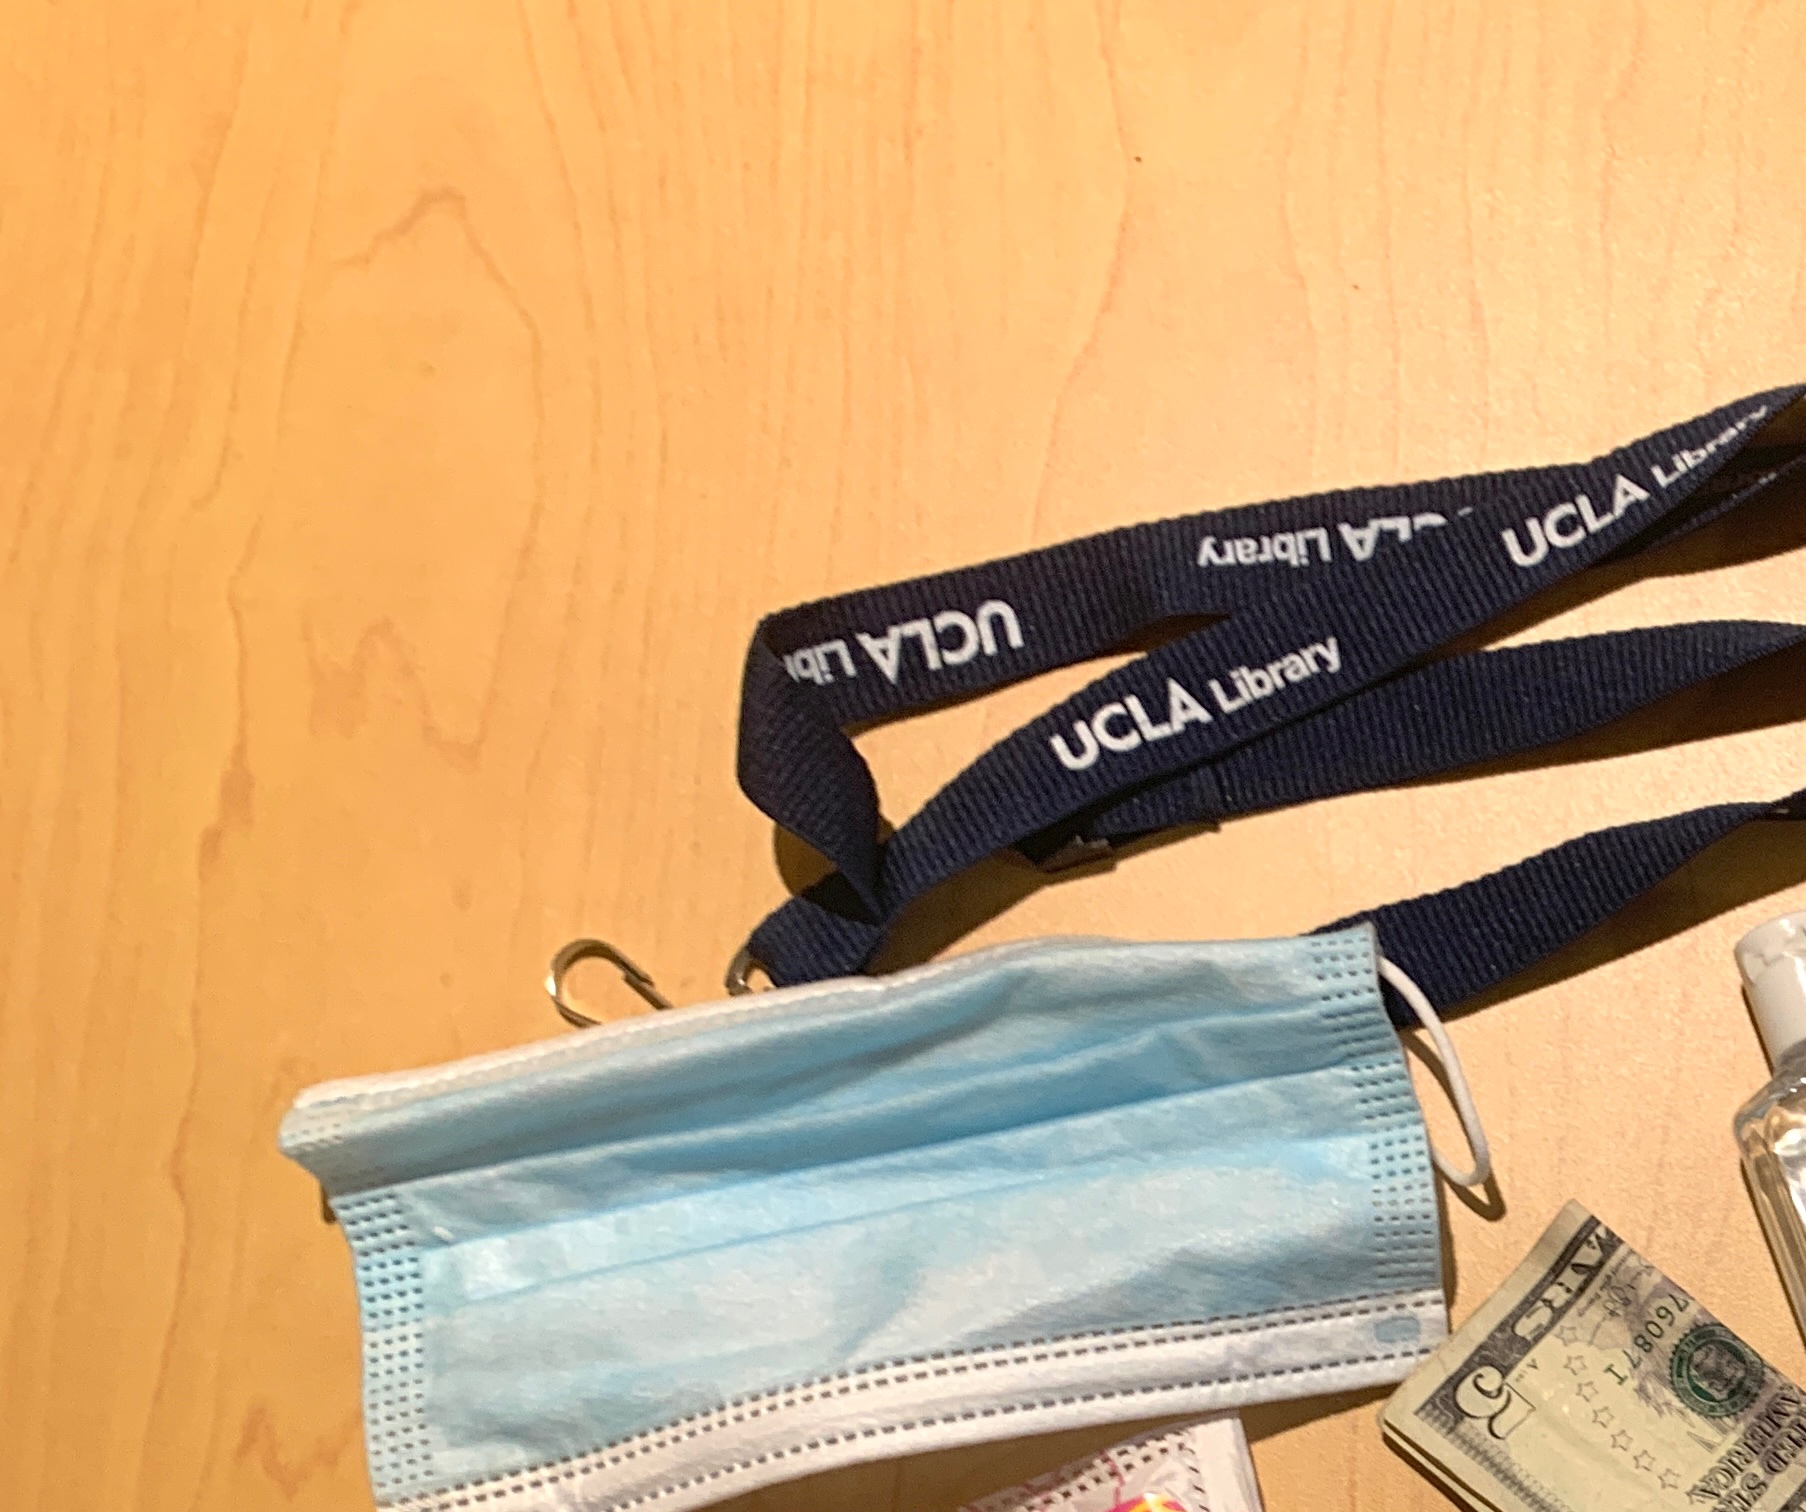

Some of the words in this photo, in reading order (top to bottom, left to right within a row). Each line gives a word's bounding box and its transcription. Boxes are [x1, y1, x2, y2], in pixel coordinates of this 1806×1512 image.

[1198, 526, 1332, 568] Library
[1502, 473, 1650, 568] UCLA
[856, 600, 1025, 684] UCLA
[1050, 676, 1213, 771] UCLA
[1208, 636, 1341, 715] Library
[1447, 1357, 1537, 1445] 5
